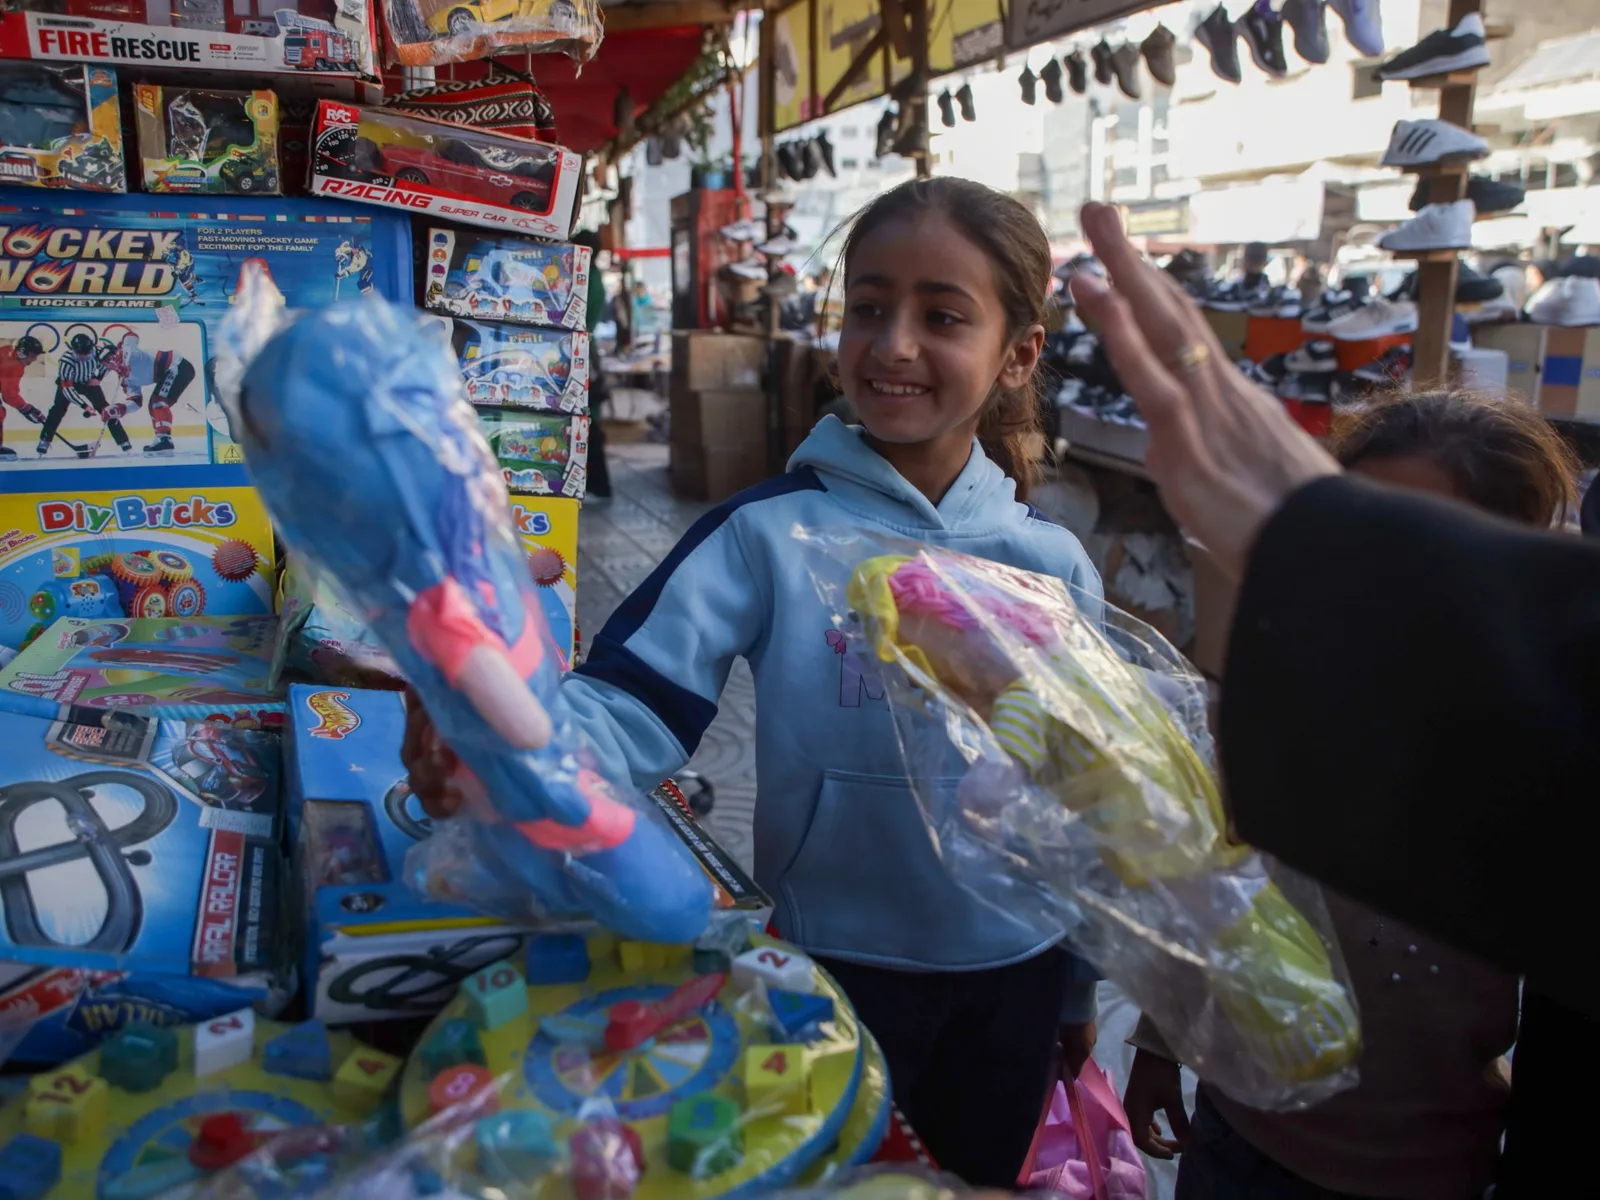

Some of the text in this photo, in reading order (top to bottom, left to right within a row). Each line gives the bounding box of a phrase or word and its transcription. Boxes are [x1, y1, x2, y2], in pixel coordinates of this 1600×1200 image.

[38, 29, 200, 62] FIRE RESCUE
[320, 178, 507, 223] RACING SUPER CAR
[198, 243, 246, 251] EXCITMENT
[25, 298, 156, 308] HOCKEY GAME
[40, 496, 235, 532] Diy Bricks
[320, 639, 341, 647] OPEN
[759, 950, 790, 968] 2
[475, 969, 515, 992] 10
[761, 1051, 788, 1075] 4
[37, 1073, 94, 1104] 12
[445, 1072, 477, 1097] 8
